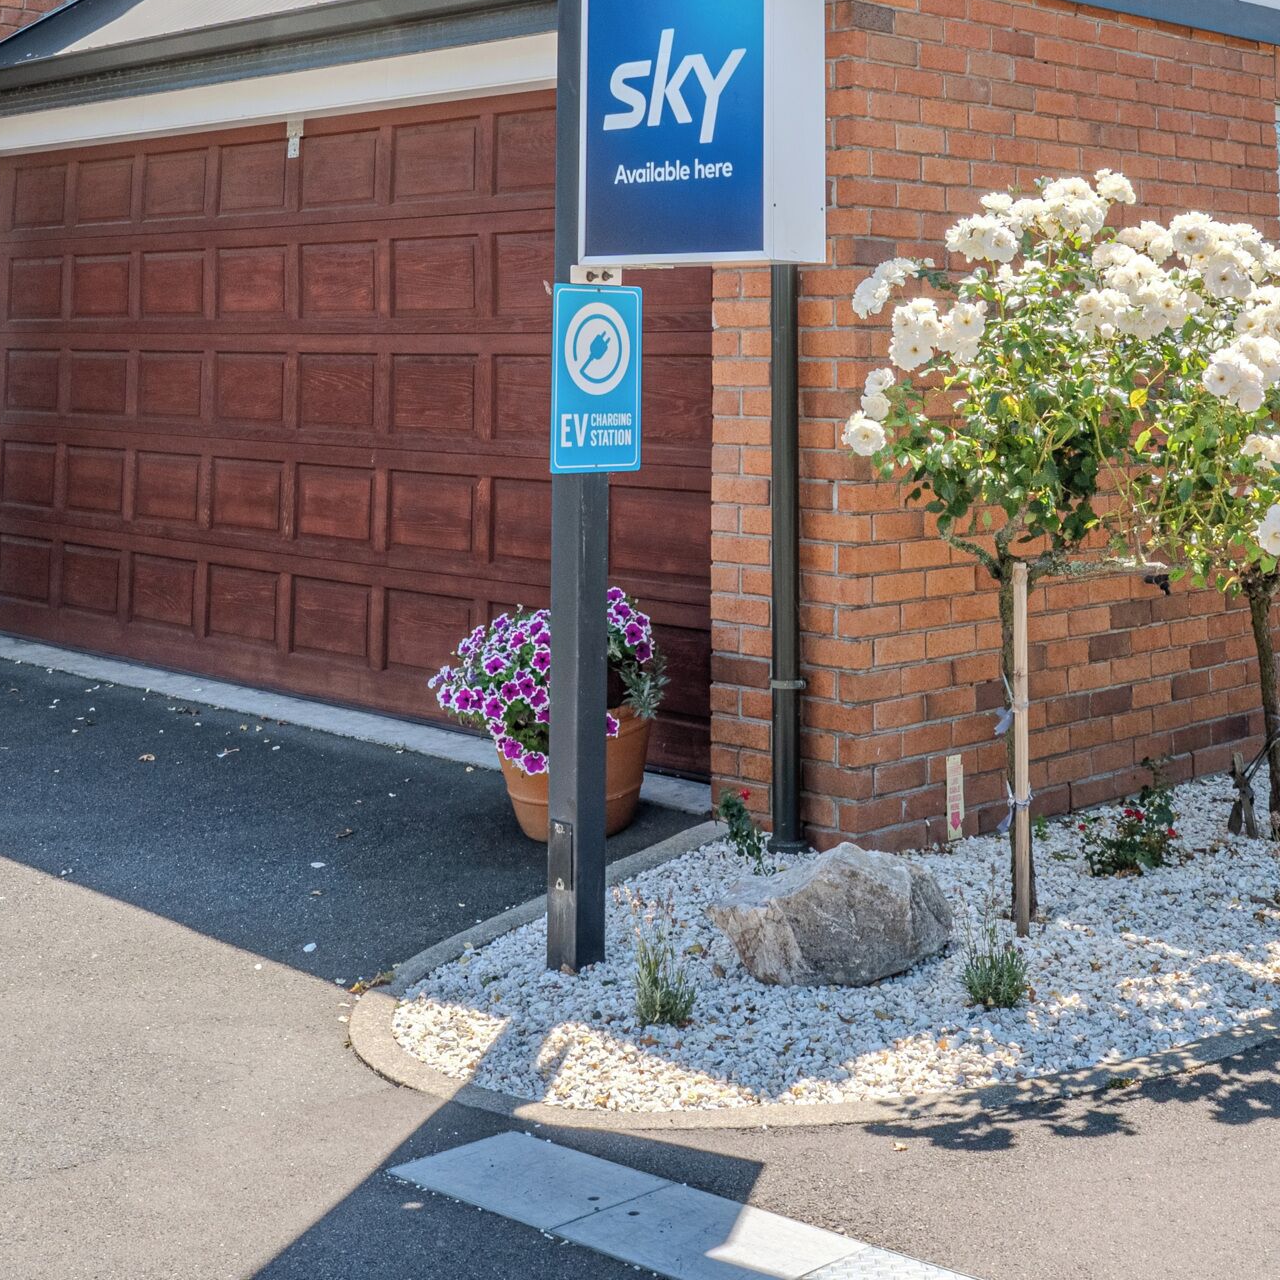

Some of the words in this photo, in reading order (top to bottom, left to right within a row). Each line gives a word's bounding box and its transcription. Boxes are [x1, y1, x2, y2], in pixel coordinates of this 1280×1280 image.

[603, 28, 747, 144] sky
[614, 159, 691, 185] Available
[694, 158, 734, 179] here
[561, 413, 589, 448] EV
[590, 413, 632, 427] CHARGING
[590, 429, 632, 446] STATION
